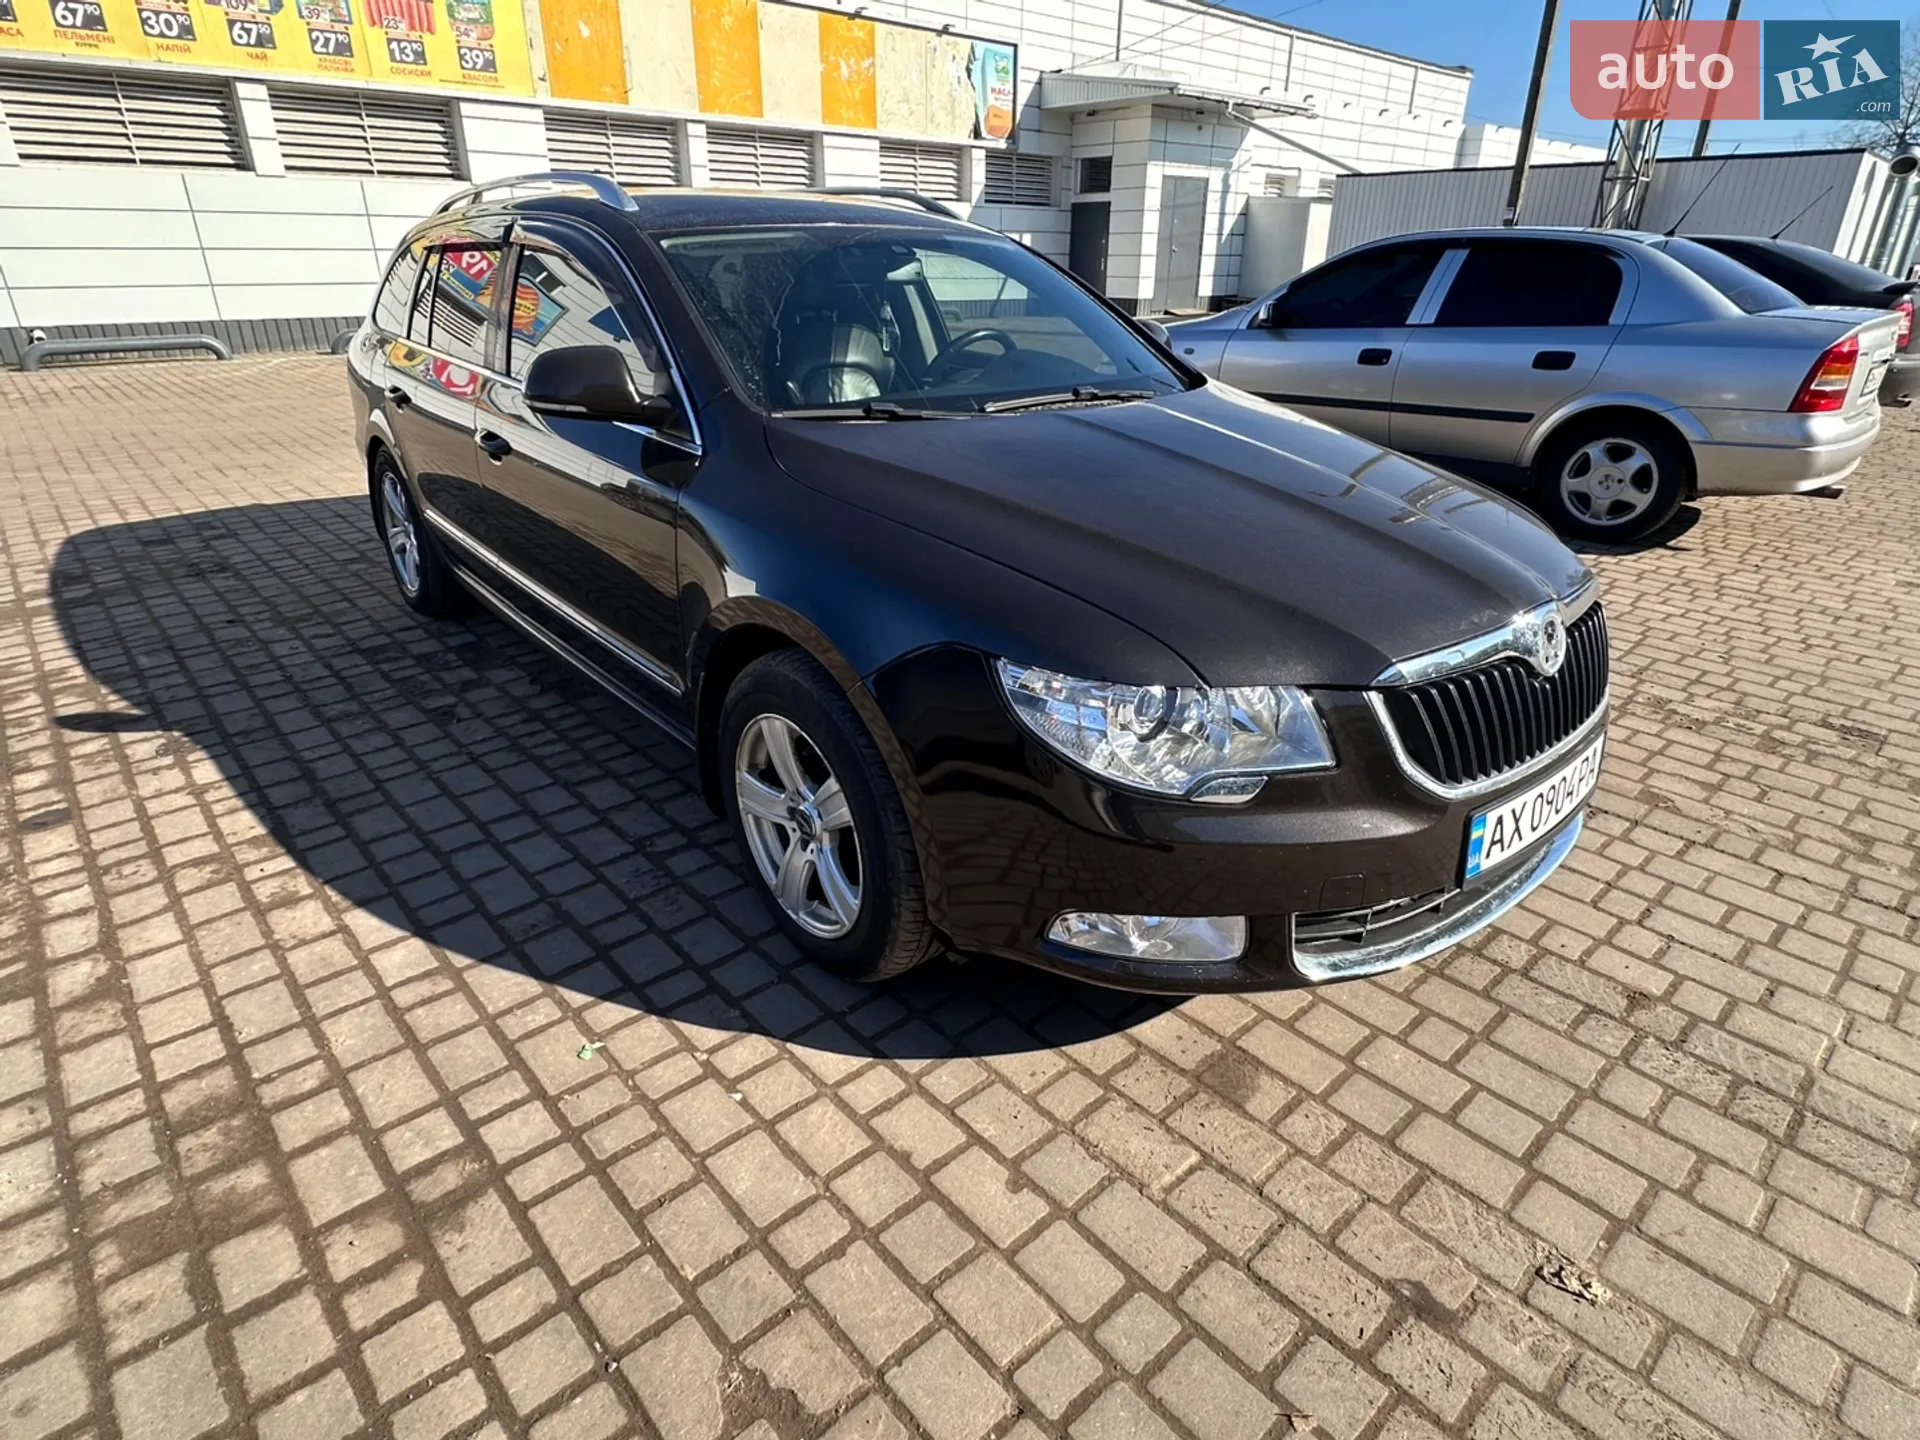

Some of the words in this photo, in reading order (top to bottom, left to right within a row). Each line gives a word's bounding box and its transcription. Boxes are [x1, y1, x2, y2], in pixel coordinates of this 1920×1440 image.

[54, 1, 84, 27] 67
[140, 11, 179, 37] 30
[53, 30, 116, 44] ПЕЛЬМЕНІ
[231, 22, 259, 45] 67
[310, 31, 336, 54] 27
[155, 42, 192, 54] НАПІЙ
[246, 51, 269, 62] ЧАЙ
[389, 41, 415, 62] 13
[460, 48, 484, 70] 39
[390, 66, 432, 78] СОСИСКИ
